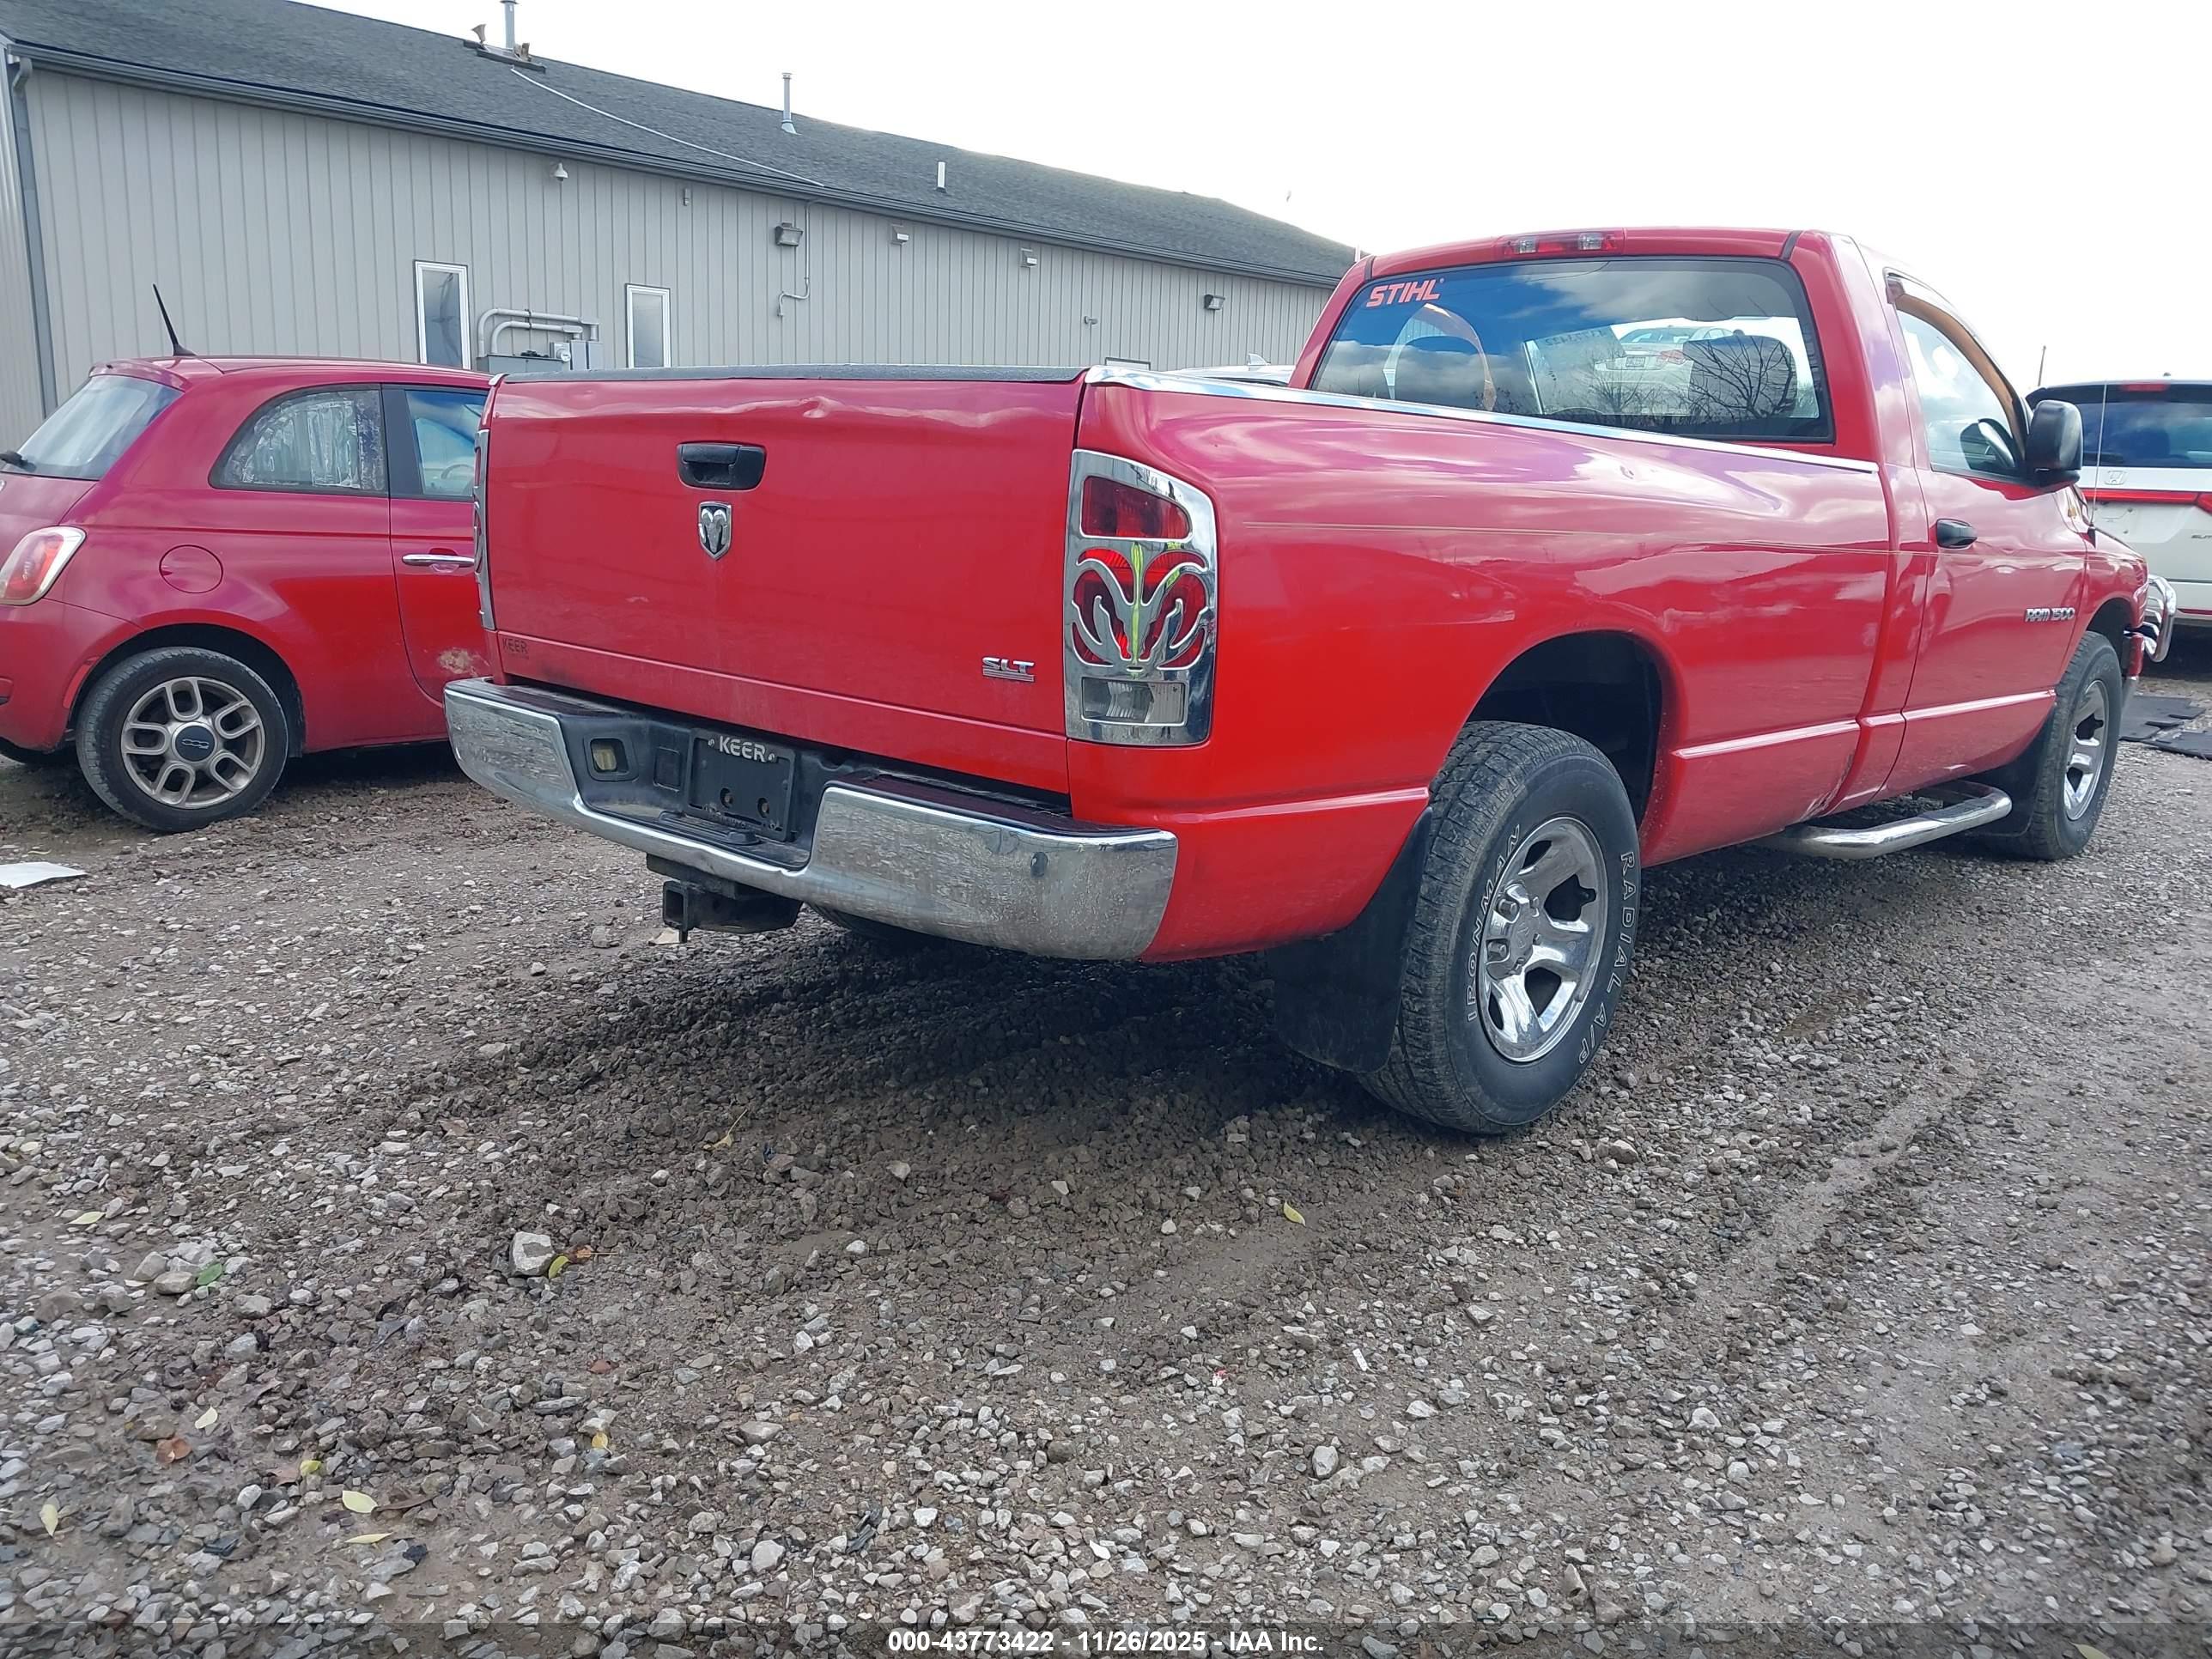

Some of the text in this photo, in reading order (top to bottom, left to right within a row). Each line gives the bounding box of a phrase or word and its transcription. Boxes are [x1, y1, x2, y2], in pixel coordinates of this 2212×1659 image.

[1366, 279, 1440, 307] STIHL
[2025, 607, 2075, 623] RAM 1500
[502, 638, 528, 653] KEER
[982, 657, 1035, 676] SLT
[720, 735, 768, 763] KEER
[1466, 824, 1520, 1022] IRONMAN
[1607, 852, 1636, 993] RADIAL
